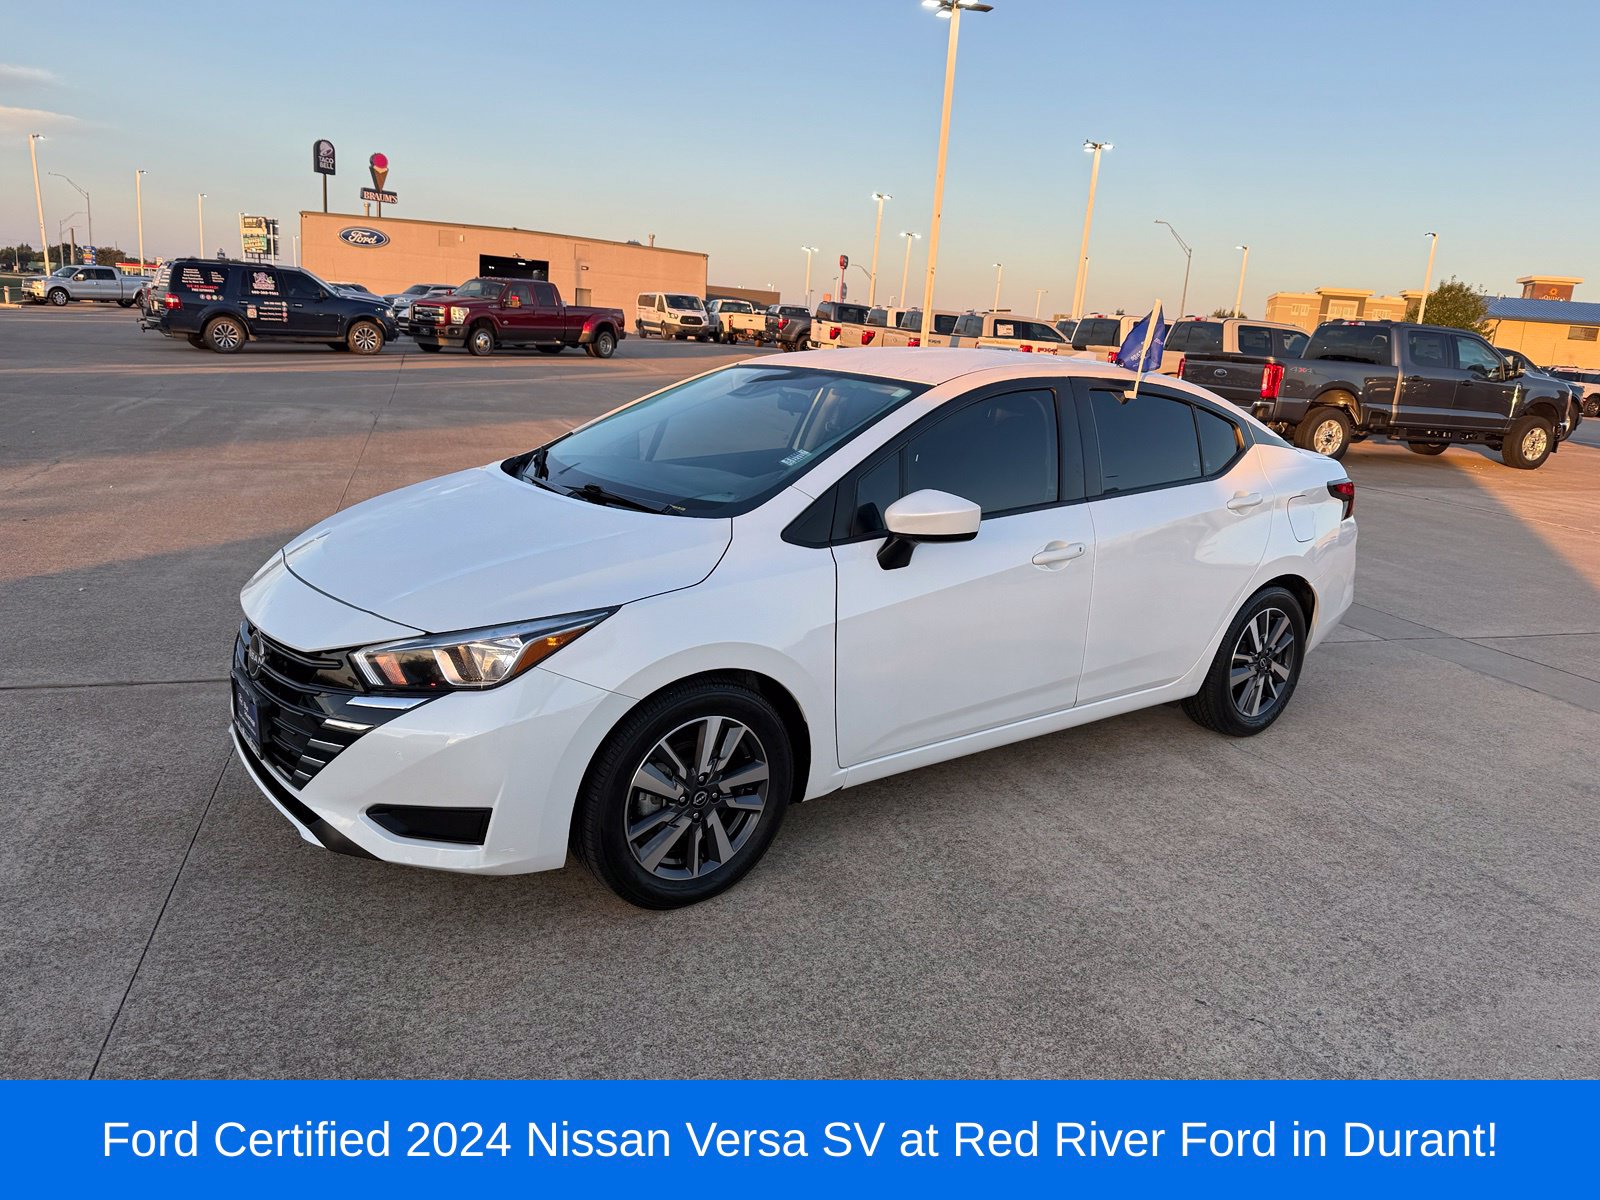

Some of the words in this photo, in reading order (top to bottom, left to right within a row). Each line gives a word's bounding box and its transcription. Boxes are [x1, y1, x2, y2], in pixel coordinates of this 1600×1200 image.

[318, 156, 334, 164] TACO
[319, 162, 334, 170] BELL
[348, 230, 377, 244] Ford
